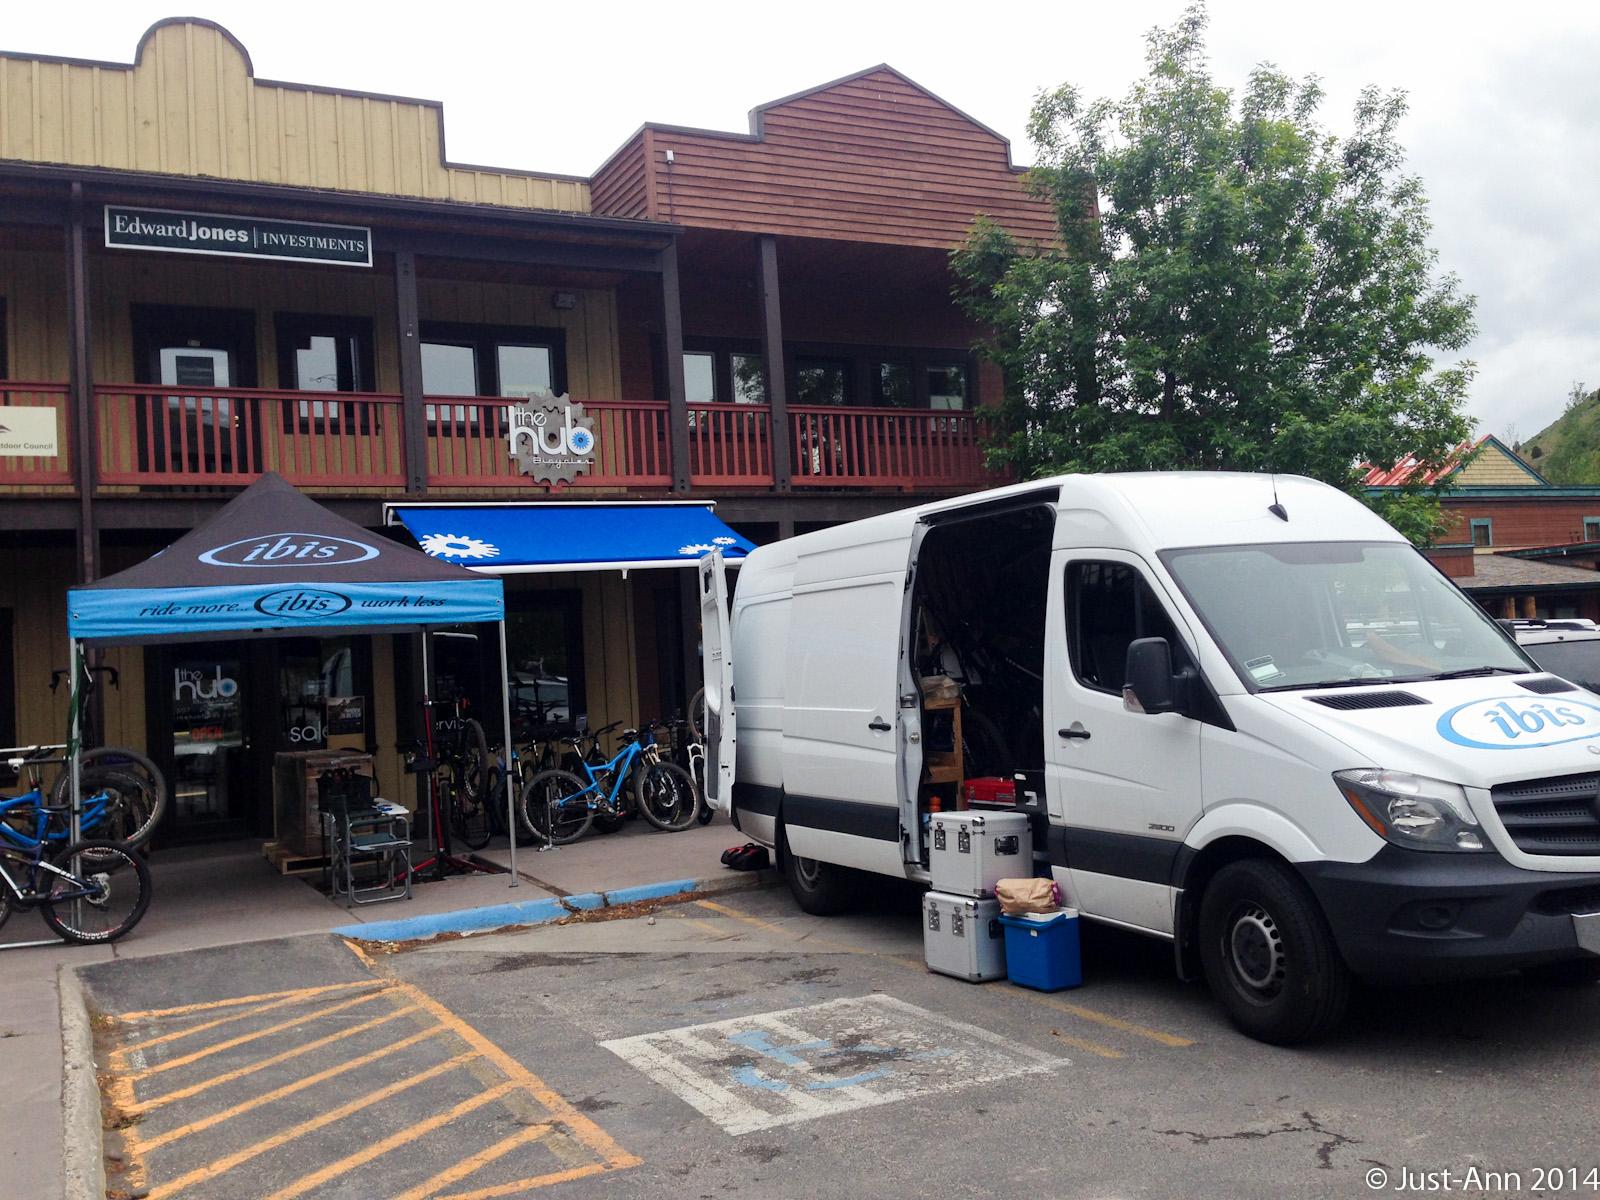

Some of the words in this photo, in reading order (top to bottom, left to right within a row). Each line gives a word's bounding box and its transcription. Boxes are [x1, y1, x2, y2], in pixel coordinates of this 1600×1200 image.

[262, 231, 366, 254] INVESTMENTS
[515, 408, 547, 427] the
[508, 405, 595, 456] hub
[532, 456, 594, 469] Bicycles
[243, 538, 339, 563] ibis
[139, 602, 181, 618] ride
[277, 594, 330, 613] ibis
[361, 595, 410, 609] work
[412, 595, 447, 608] less
[174, 664, 238, 701] hub
[180, 667, 203, 681] the
[1483, 700, 1586, 739] ibis
